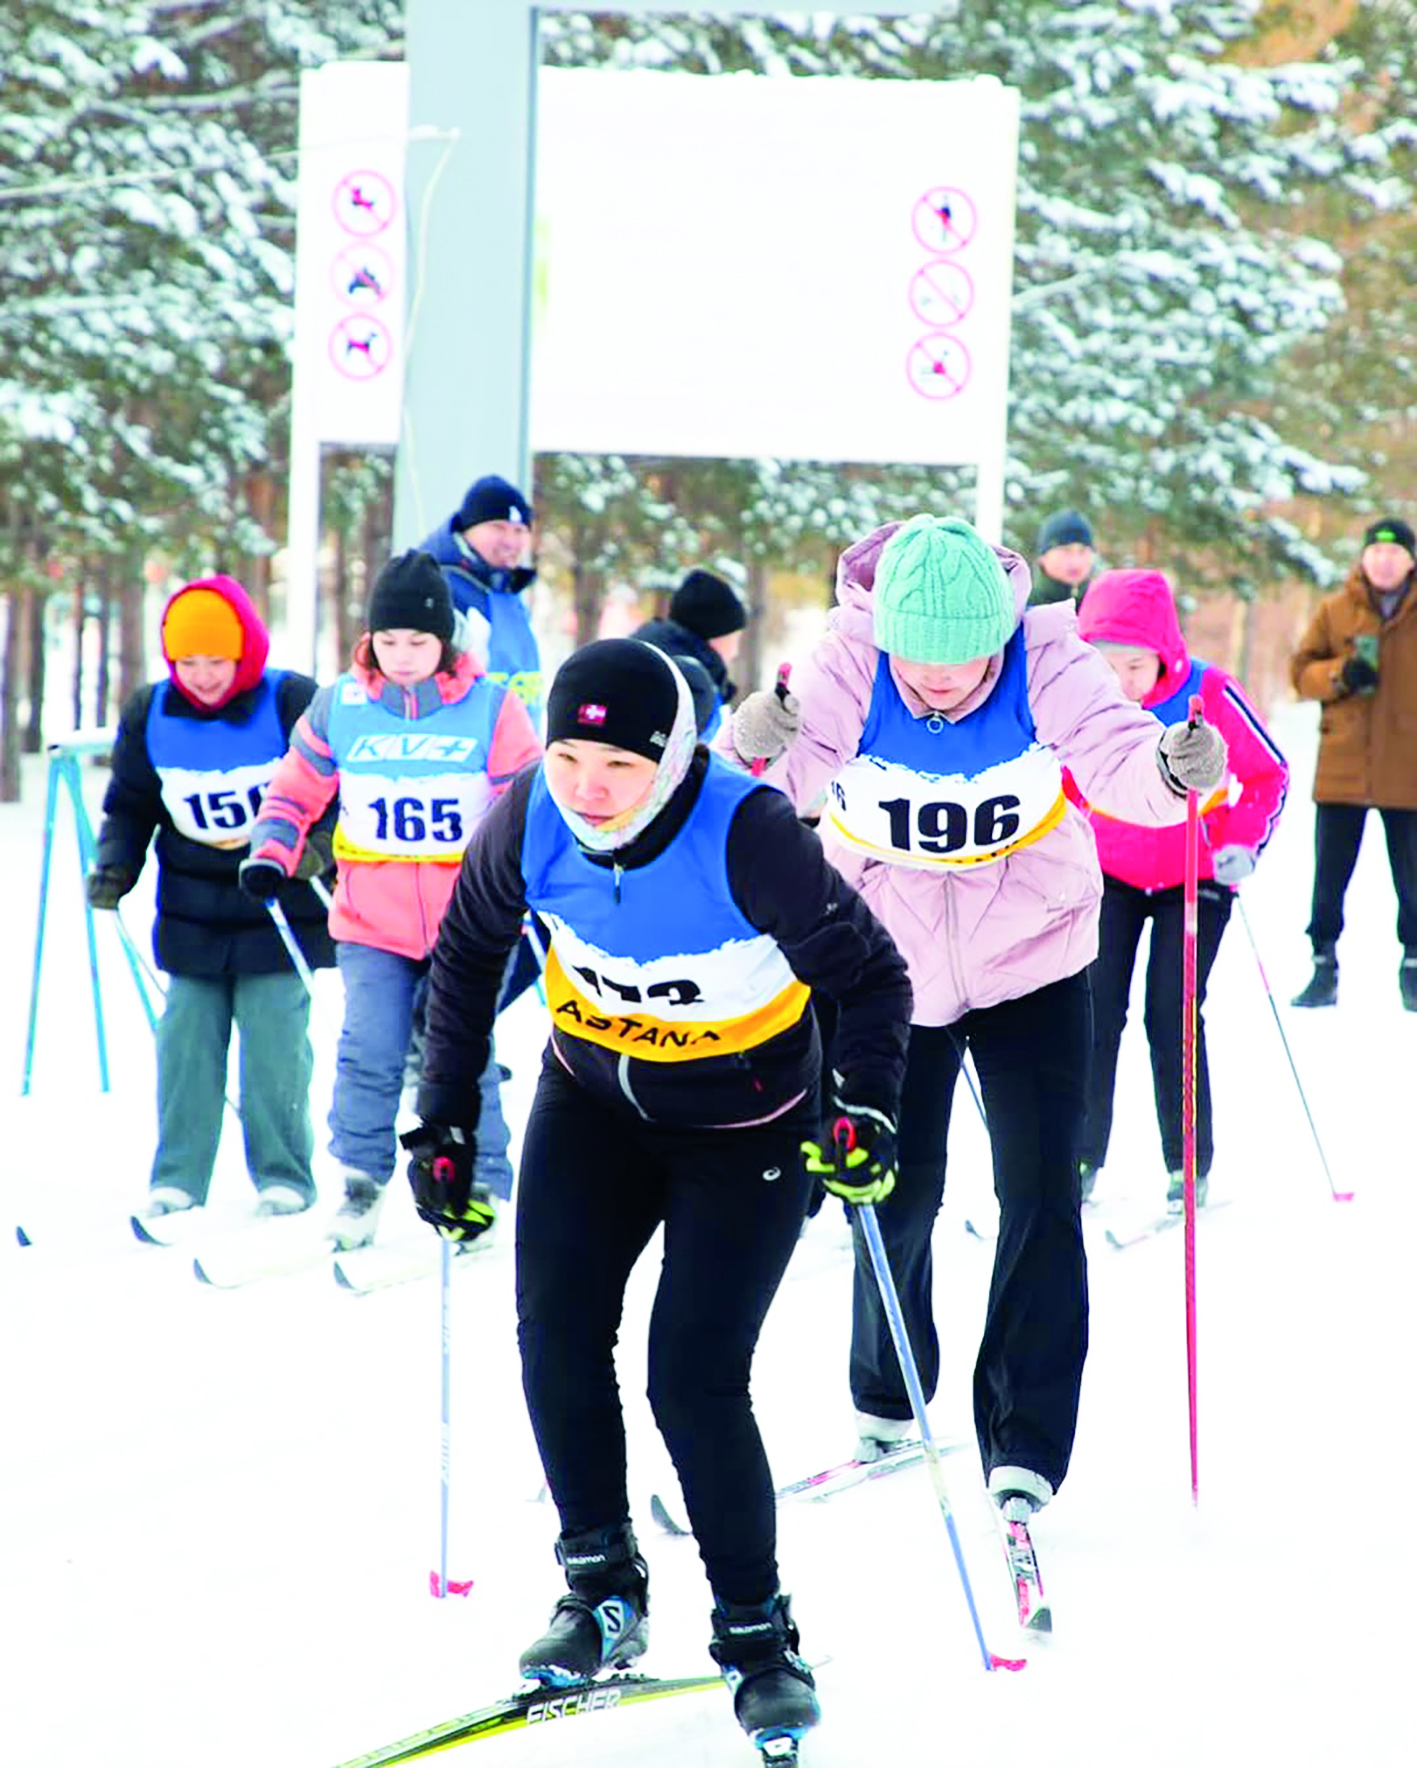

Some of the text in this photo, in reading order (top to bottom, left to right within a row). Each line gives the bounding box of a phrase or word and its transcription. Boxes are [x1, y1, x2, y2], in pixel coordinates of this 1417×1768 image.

[368, 797, 463, 842] 165
[878, 794, 1021, 853] 196
[526, 1689, 622, 1725] FISCHER
